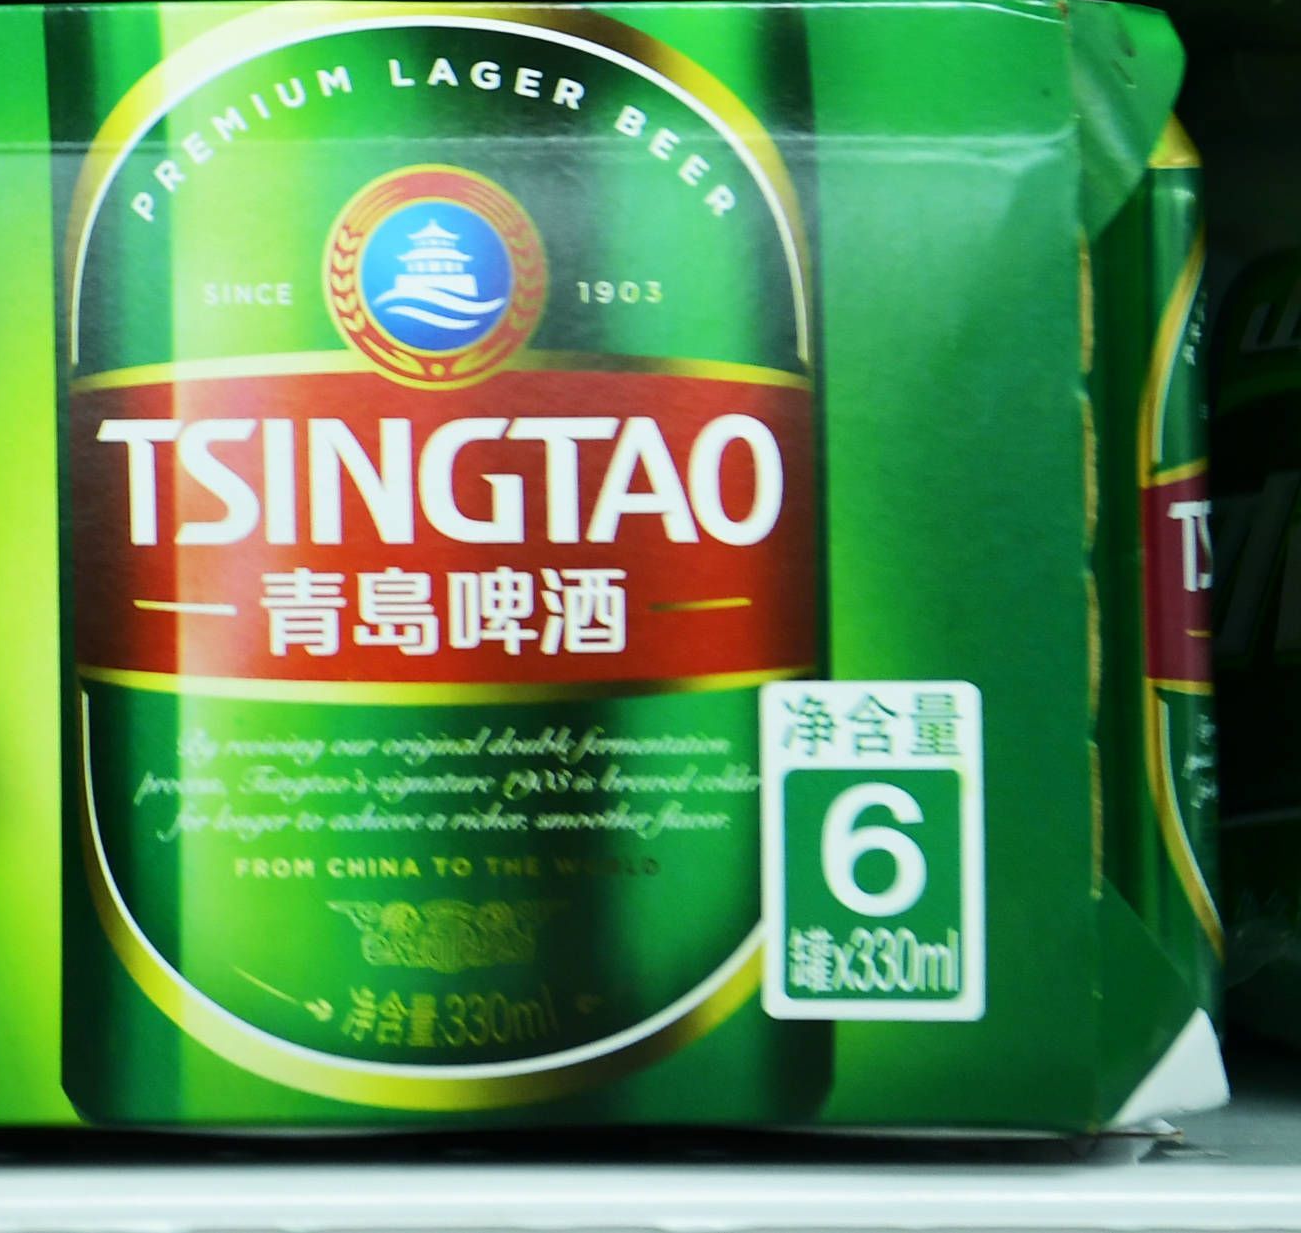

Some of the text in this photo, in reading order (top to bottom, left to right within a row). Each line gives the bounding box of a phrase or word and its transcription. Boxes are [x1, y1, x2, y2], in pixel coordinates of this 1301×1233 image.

[131, 58, 738, 224] PREMIUM LAGER BEER
[204, 280, 663, 307] SINCE 1903
[96, 413, 784, 547] TSINGTAO
[261, 565, 628, 657] 青島啤酒
[330, 739, 378, 756] our
[382, 726, 492, 765] original
[782, 693, 963, 756] 净含量
[373, 771, 495, 803] signature
[295, 811, 325, 832] to
[329, 801, 425, 832] achieve
[234, 856, 317, 878] FROM
[326, 856, 421, 878] CHINA
[430, 856, 473, 877] TO
[485, 856, 541, 877] THE
[821, 781, 928, 918] 6
